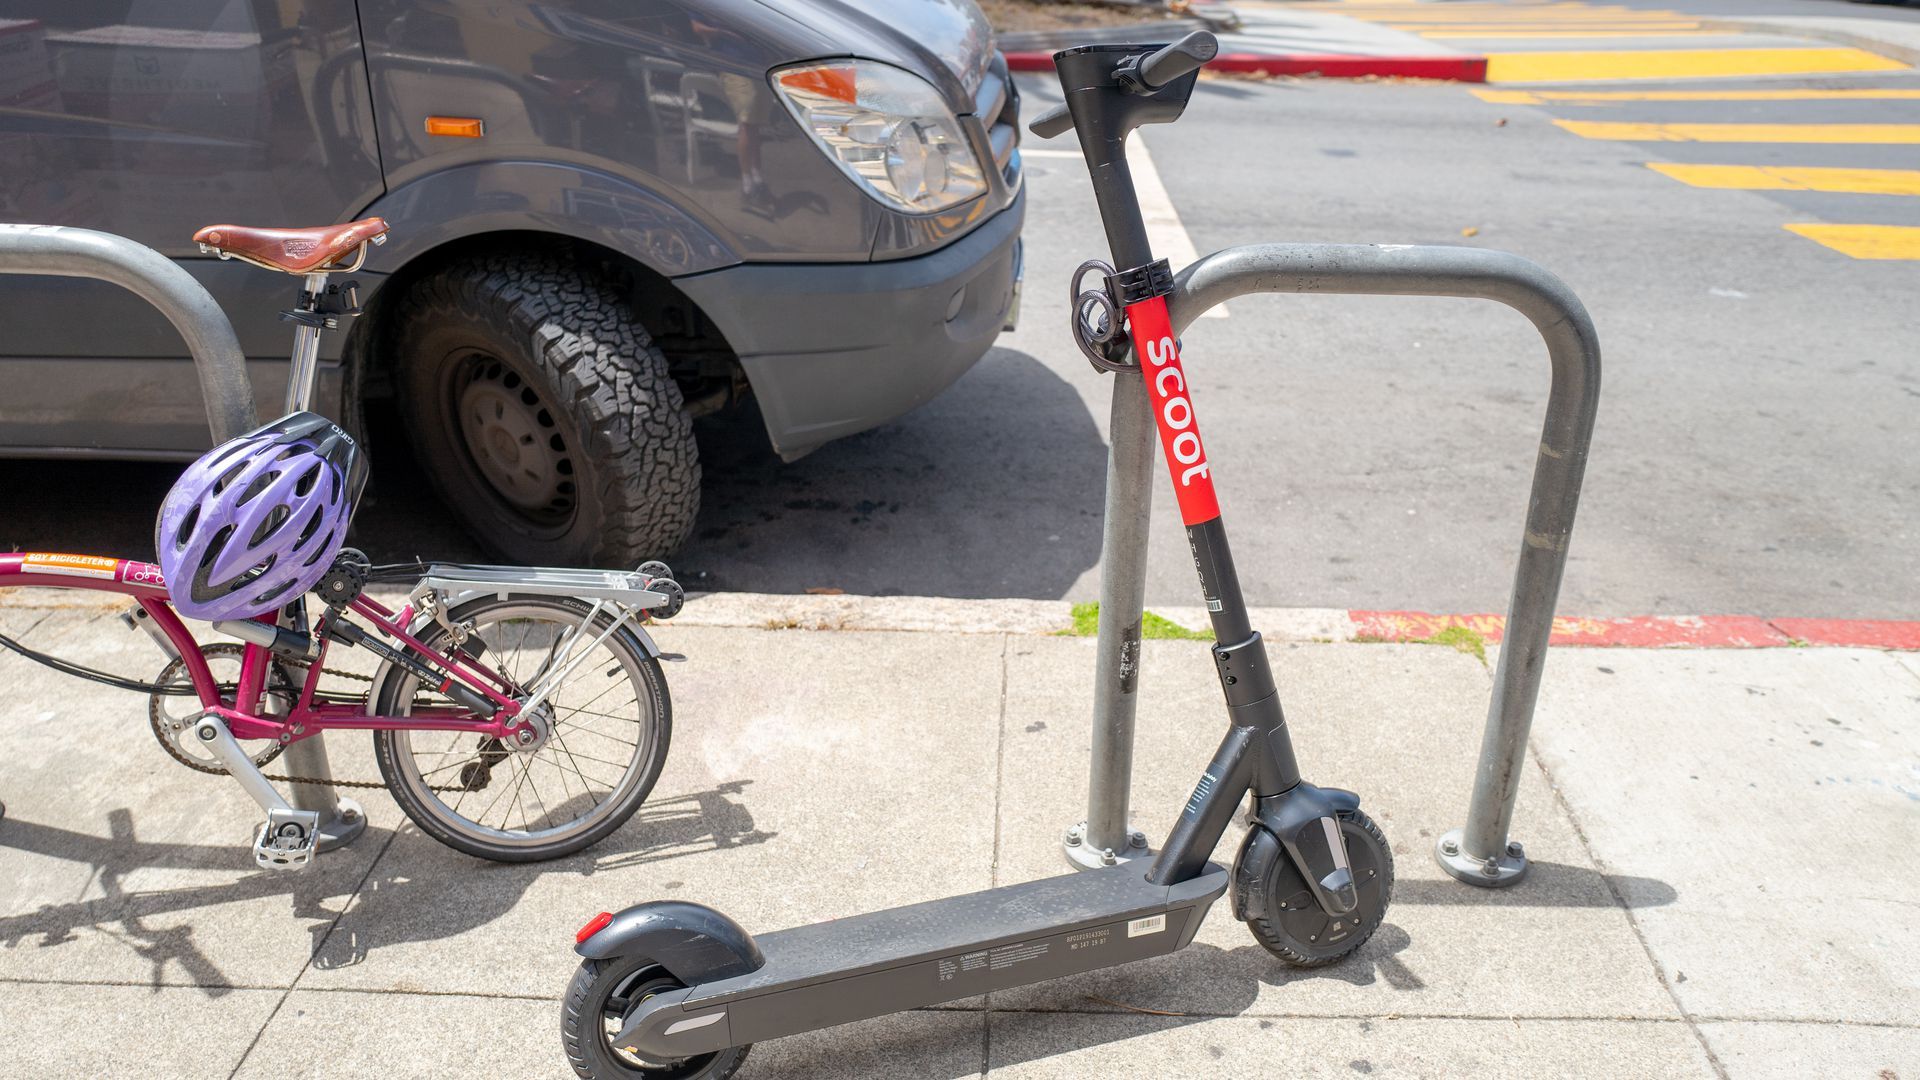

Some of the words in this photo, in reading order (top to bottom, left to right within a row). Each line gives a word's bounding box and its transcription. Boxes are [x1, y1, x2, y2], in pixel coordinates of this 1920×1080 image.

[1147, 336, 1209, 486] scoot
[331, 424, 354, 445] GIRO
[964, 951, 988, 960] WARNING
